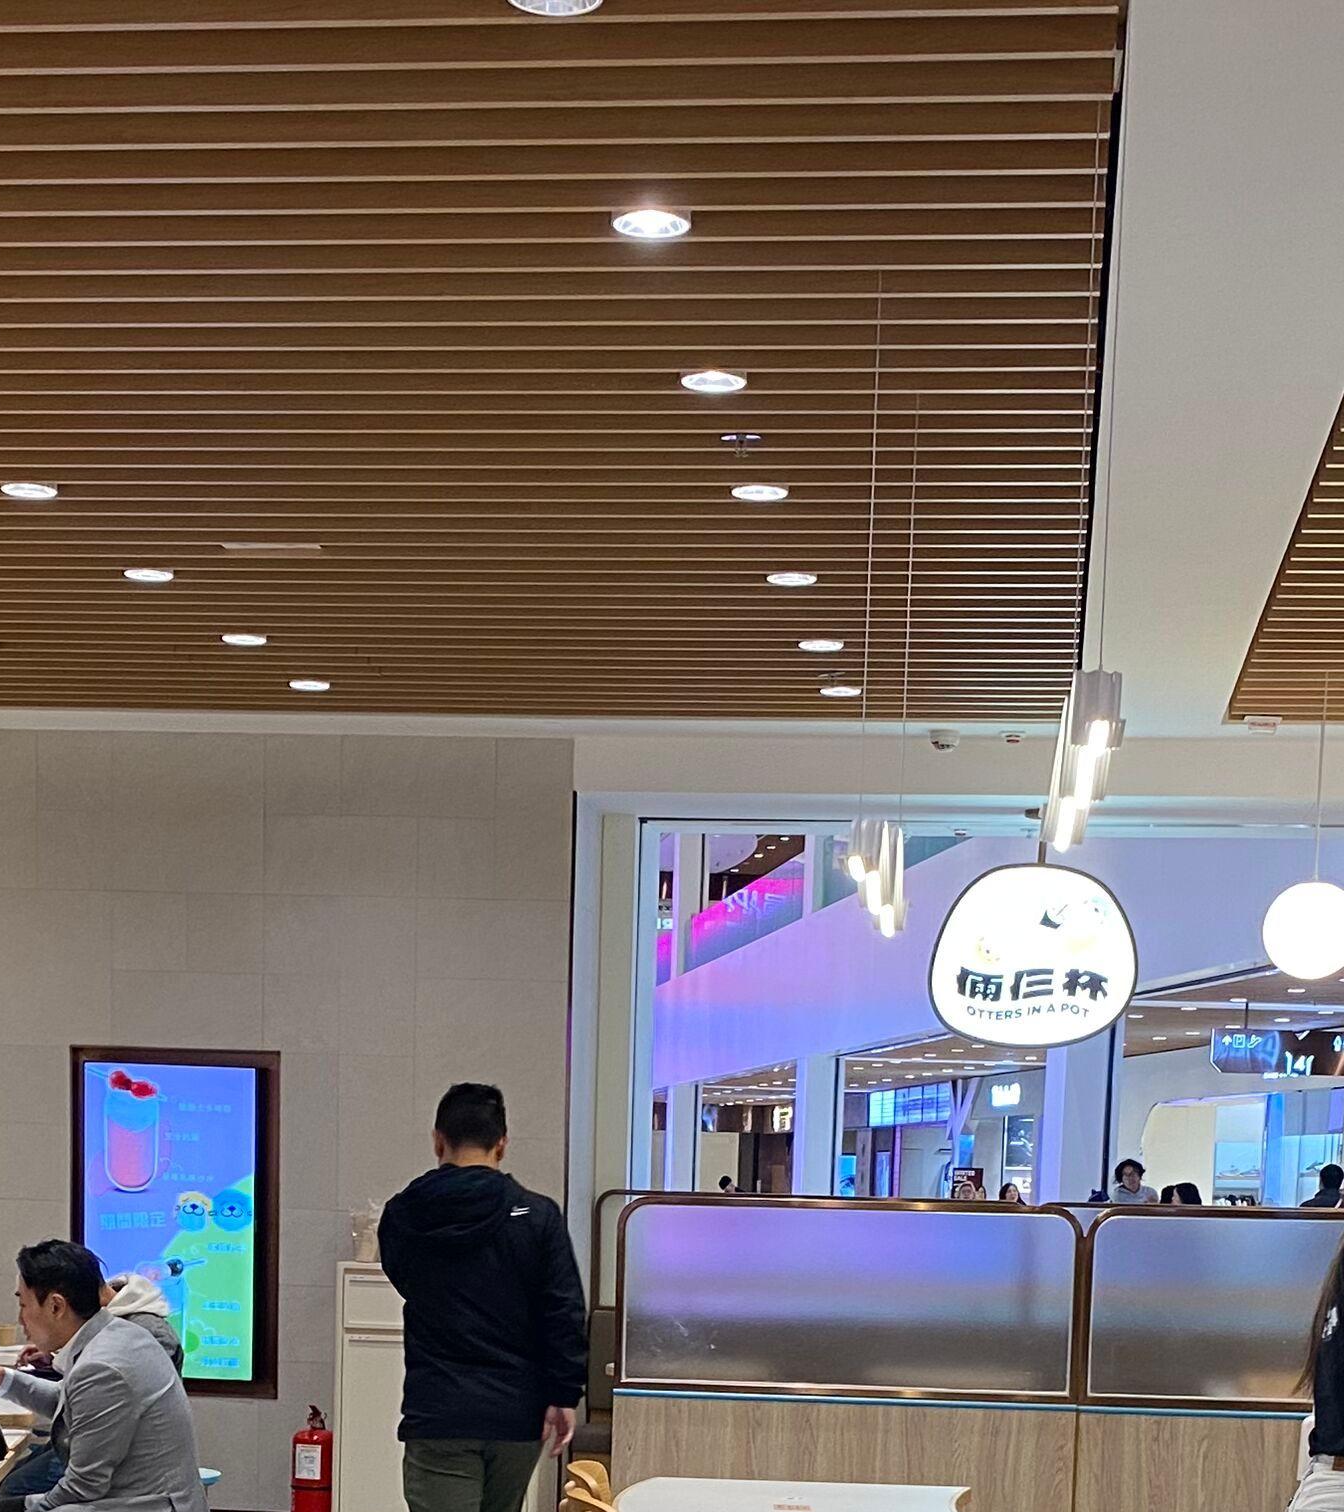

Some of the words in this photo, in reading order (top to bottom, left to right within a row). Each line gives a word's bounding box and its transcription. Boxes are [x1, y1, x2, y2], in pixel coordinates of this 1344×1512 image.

[967, 1005, 1022, 1020] OTTERS
[1027, 1006, 1041, 1016] IN
[1047, 1004, 1056, 1012] A
[1061, 1003, 1090, 1018] POT
